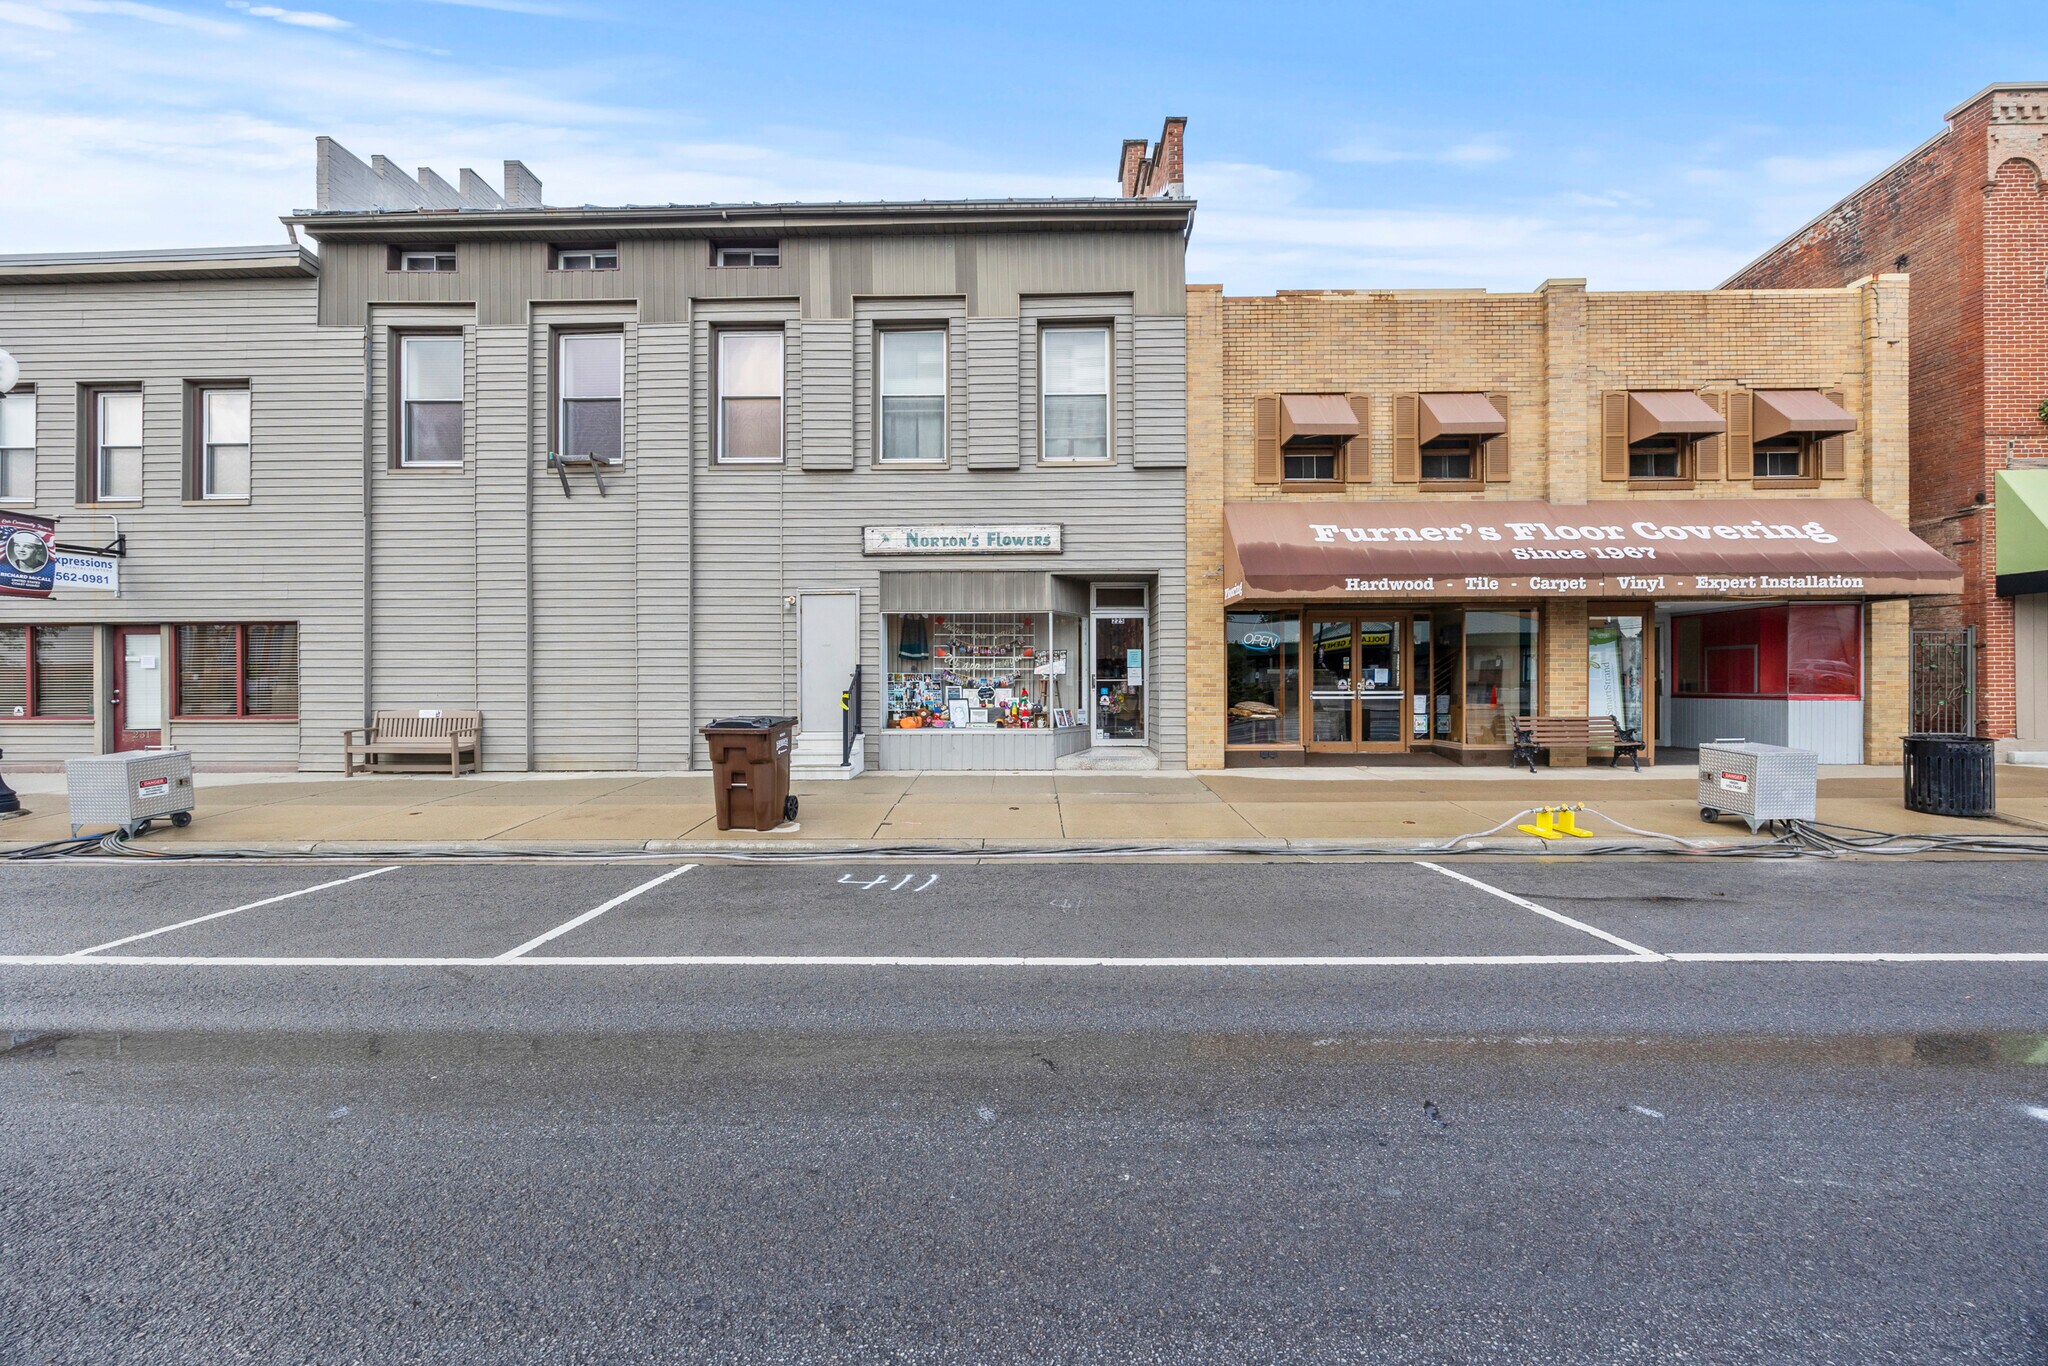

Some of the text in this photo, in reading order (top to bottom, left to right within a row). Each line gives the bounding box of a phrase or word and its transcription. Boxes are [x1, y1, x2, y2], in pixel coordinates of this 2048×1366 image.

[1308, 521, 1838, 544] Furner's Floor Covering
[1511, 546, 1657, 560] Since 1967
[55, 571, 109, 584] 562-0981
[1345, 577, 1434, 591] Hardwood
[1465, 577, 1499, 590] Tile
[1529, 577, 1587, 592] Carpet
[1617, 576, 1665, 592] Vinyl
[1695, 576, 1756, 591] Expert
[1760, 575, 1864, 588] Installation
[1243, 632, 1278, 648] OPEN
[1601, 661, 1614, 716] SmartStrand
[837, 873, 938, 892] 411
